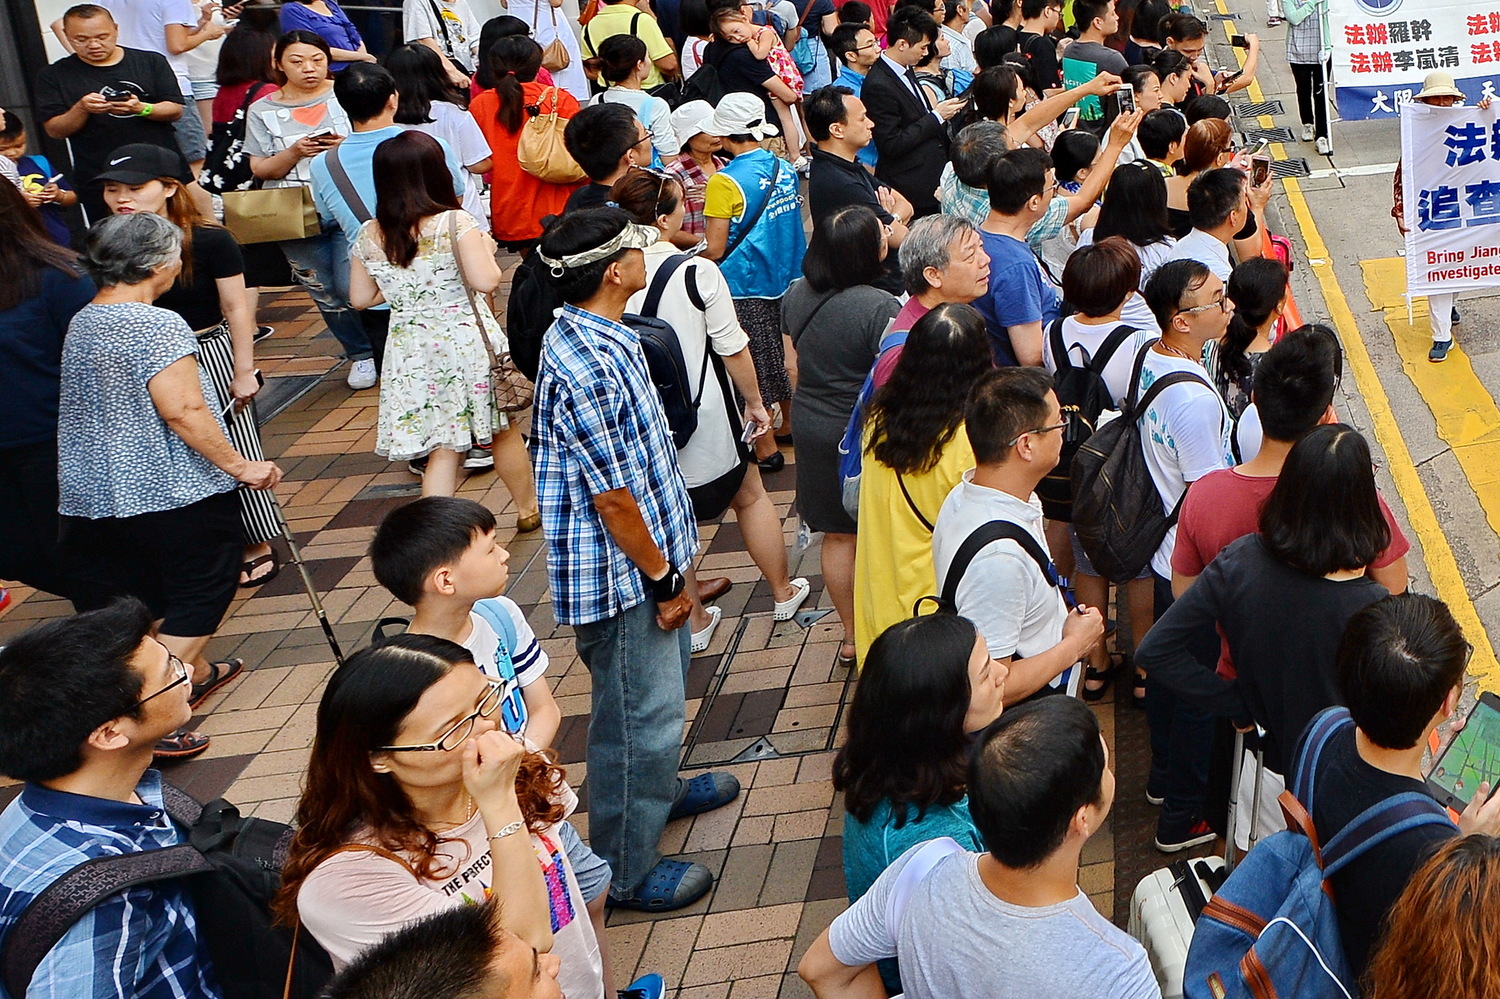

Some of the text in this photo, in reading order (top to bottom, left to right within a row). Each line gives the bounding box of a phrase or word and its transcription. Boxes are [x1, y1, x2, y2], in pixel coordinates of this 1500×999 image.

[1344, 18, 1433, 46] 法辦羅幹
[1350, 45, 1460, 74] 法辦李嵐清
[1426, 250, 1464, 264] Bring
[441, 877, 463, 897] THE
